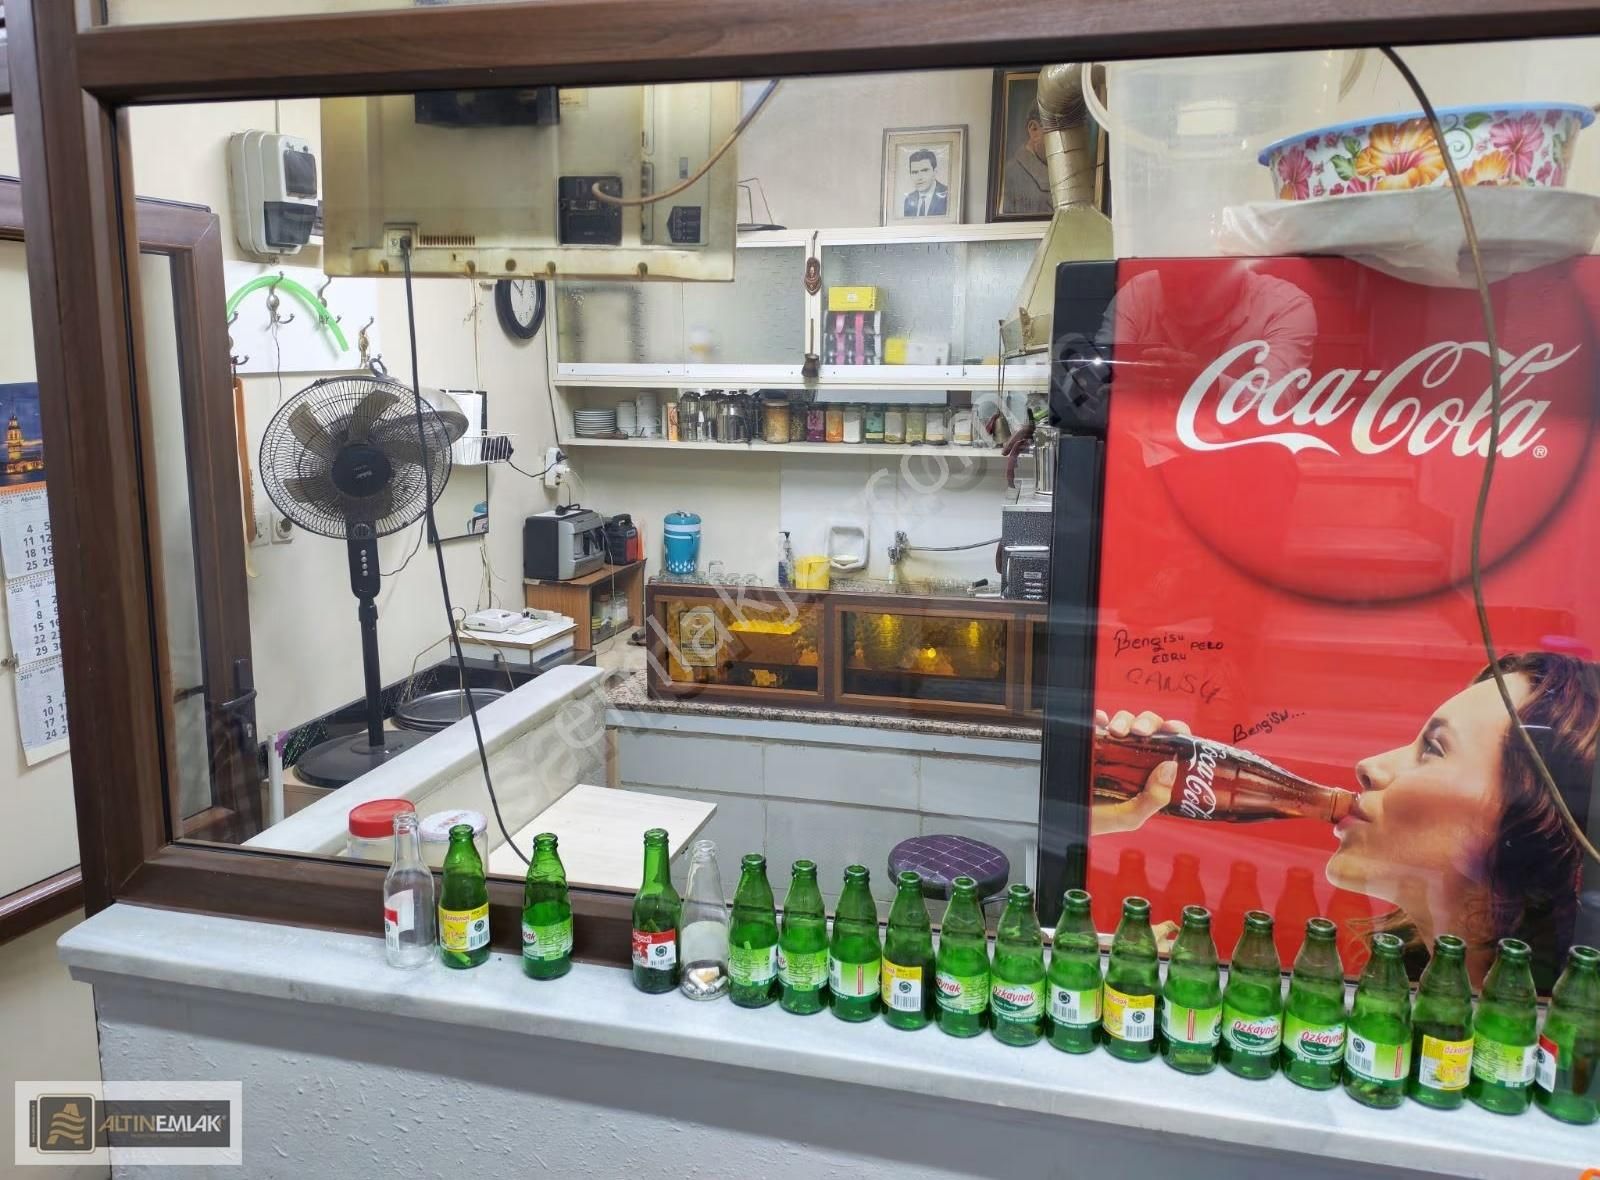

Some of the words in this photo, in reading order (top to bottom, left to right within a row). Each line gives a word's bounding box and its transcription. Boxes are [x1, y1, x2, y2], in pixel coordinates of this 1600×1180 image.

[1175, 339, 1582, 458] Coca-Cola
[27, 524, 33, 533] 4
[44, 521, 50, 531] 5
[24, 537, 34, 546] 11
[40, 534, 52, 543] 12
[25, 549, 36, 558] 18
[26, 561, 38, 571] 25
[35, 599, 40, 608] 1
[37, 610, 43, 620] 8
[33, 623, 44, 632] 15
[34, 635, 46, 645] 22
[36, 646, 48, 656] 29
[46, 695, 52, 704] 3
[43, 706, 54, 717] 10
[45, 718, 55, 729] 17
[45, 729, 57, 740] 24
